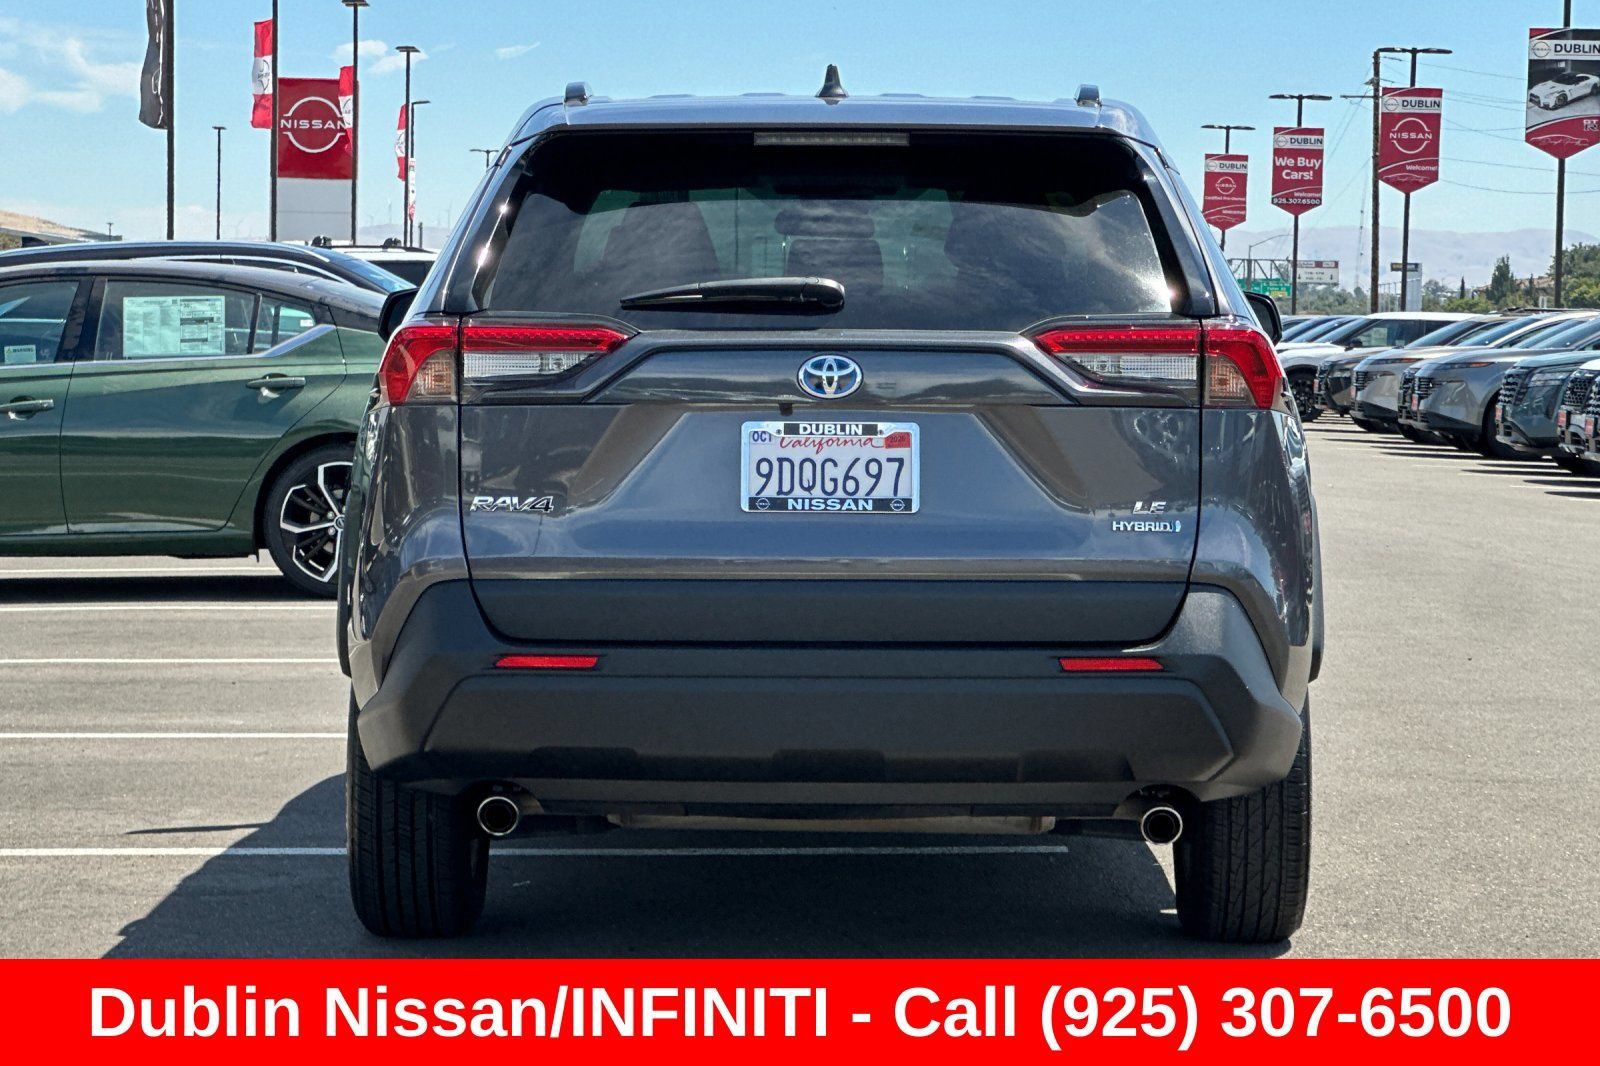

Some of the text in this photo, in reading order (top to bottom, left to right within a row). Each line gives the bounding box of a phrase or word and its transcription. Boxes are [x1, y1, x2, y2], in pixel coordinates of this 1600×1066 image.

[1554, 43, 1600, 54] DUBLIN
[1402, 99, 1440, 108] DUBLIN
[280, 119, 346, 129] NISSAN
[1290, 137, 1323, 145] DUBLIN
[1389, 132, 1432, 140] NISSAN
[1274, 156, 1321, 170] We Buy
[1282, 169, 1314, 180] Cars!
[799, 423, 862, 436] DUBLIN
[779, 436, 885, 455] California
[755, 457, 905, 497] 9DQG697
[470, 495, 555, 513] RAV4
[787, 498, 873, 511] NISSAN
[1133, 501, 1167, 515] LE
[1112, 520, 1173, 532] HYBRID
